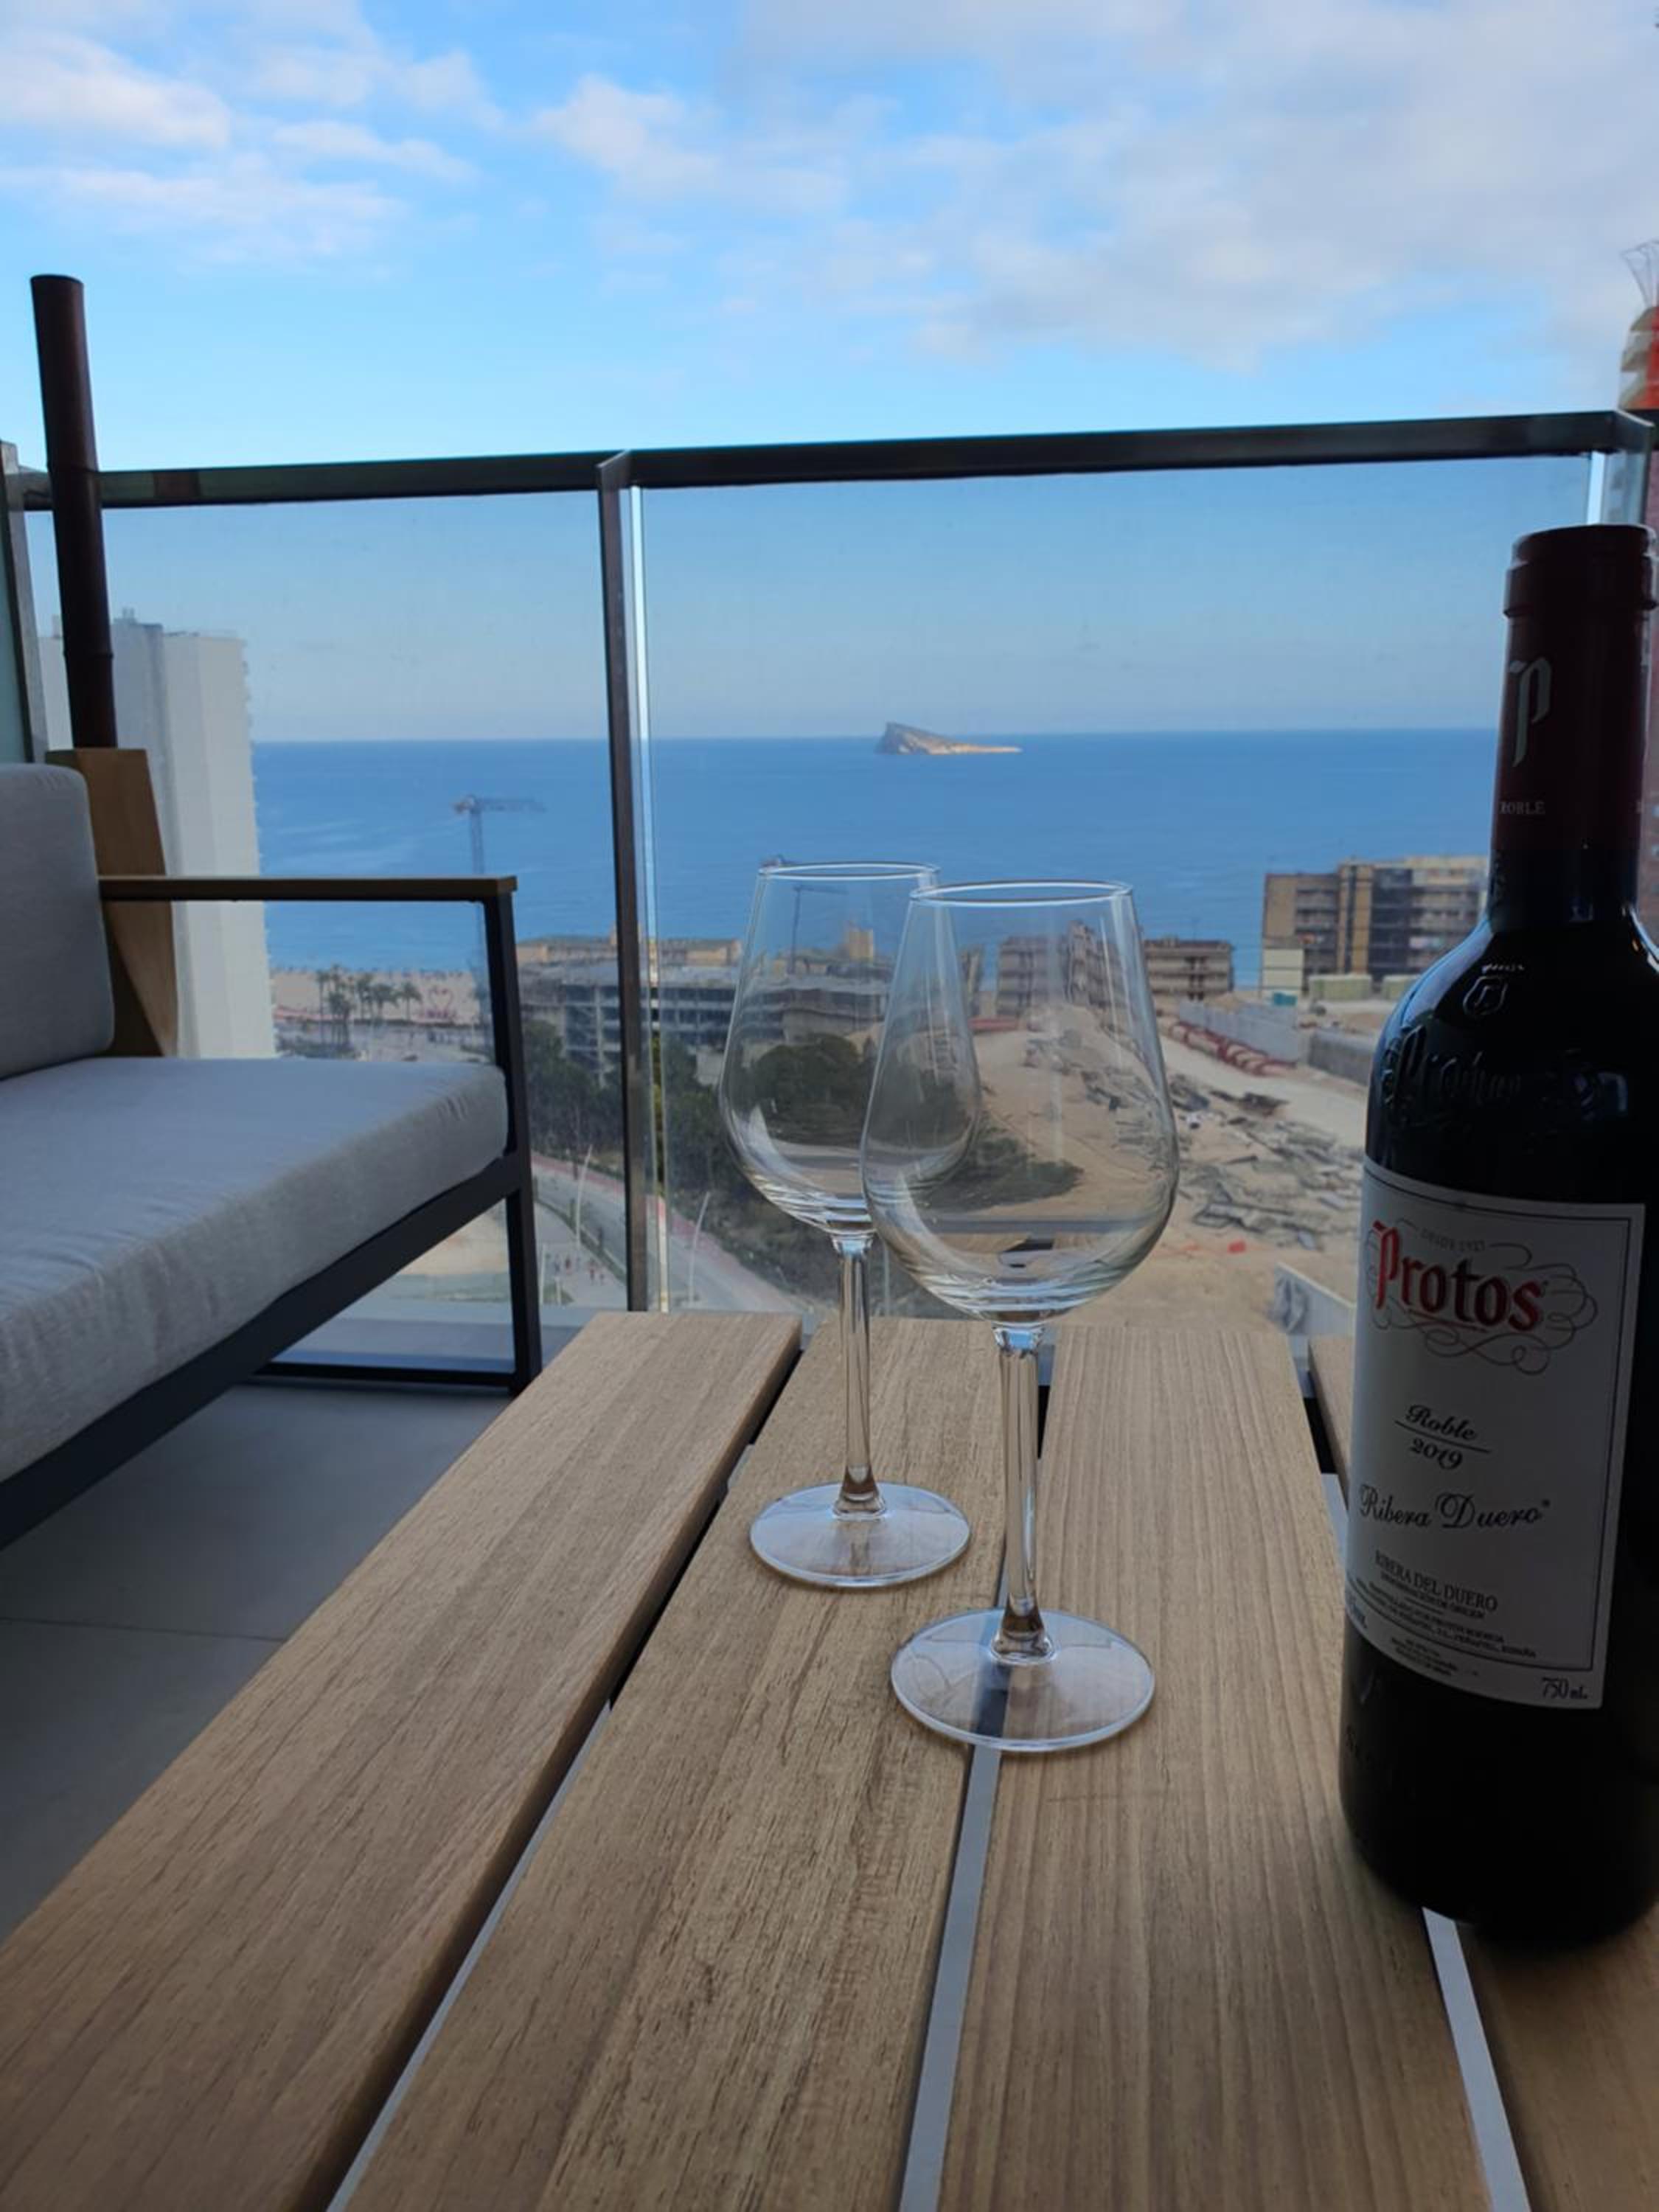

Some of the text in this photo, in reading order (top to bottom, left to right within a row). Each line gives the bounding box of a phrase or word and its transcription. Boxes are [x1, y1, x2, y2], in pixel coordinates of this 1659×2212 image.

[1372, 1220, 1543, 1332] Protos
[1405, 1403, 1477, 1441] Roble
[1410, 1438, 1464, 1471] 2019
[1359, 1484, 1543, 1529] Ribera Duero
[1413, 1571, 1441, 1596] DEL
[1443, 1583, 1499, 1612] DUERO
[1542, 1676, 1569, 1699] 750
